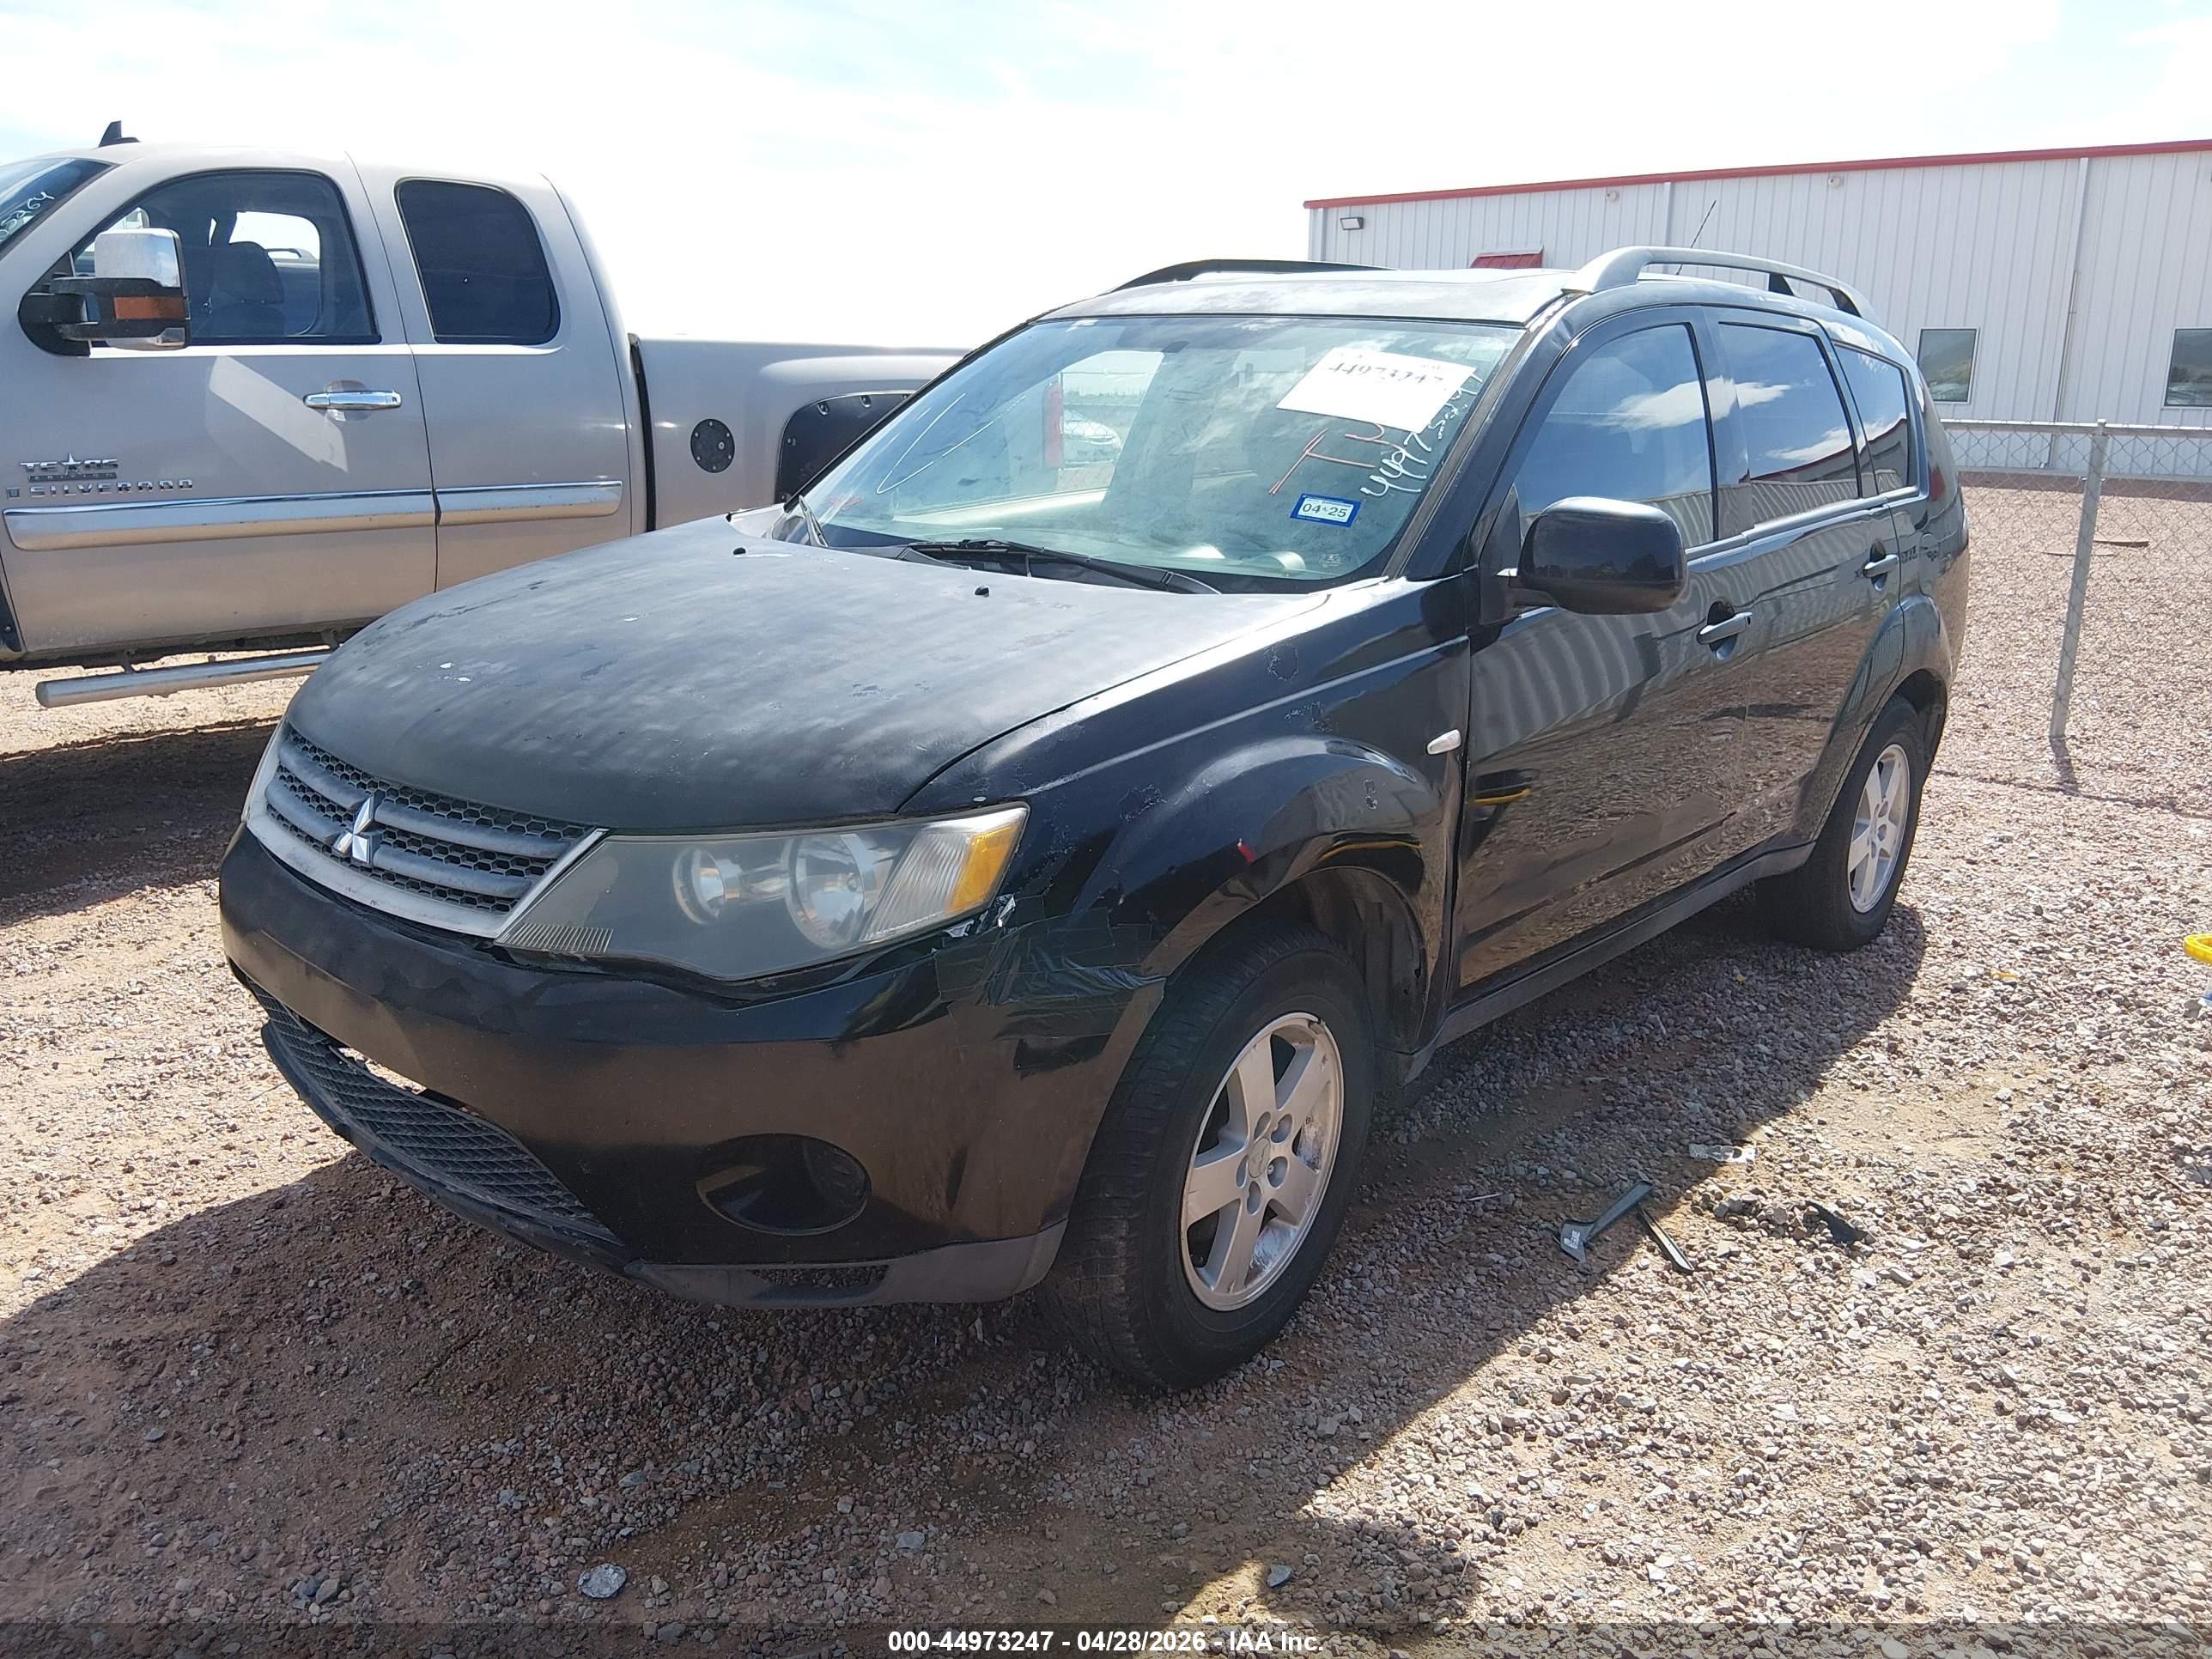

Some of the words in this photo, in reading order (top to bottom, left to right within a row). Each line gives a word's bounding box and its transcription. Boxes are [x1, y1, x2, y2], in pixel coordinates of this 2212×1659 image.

[29, 478, 193, 498] SILVERADO
[1302, 503, 1322, 514] 04
[1328, 507, 1347, 518] 25
